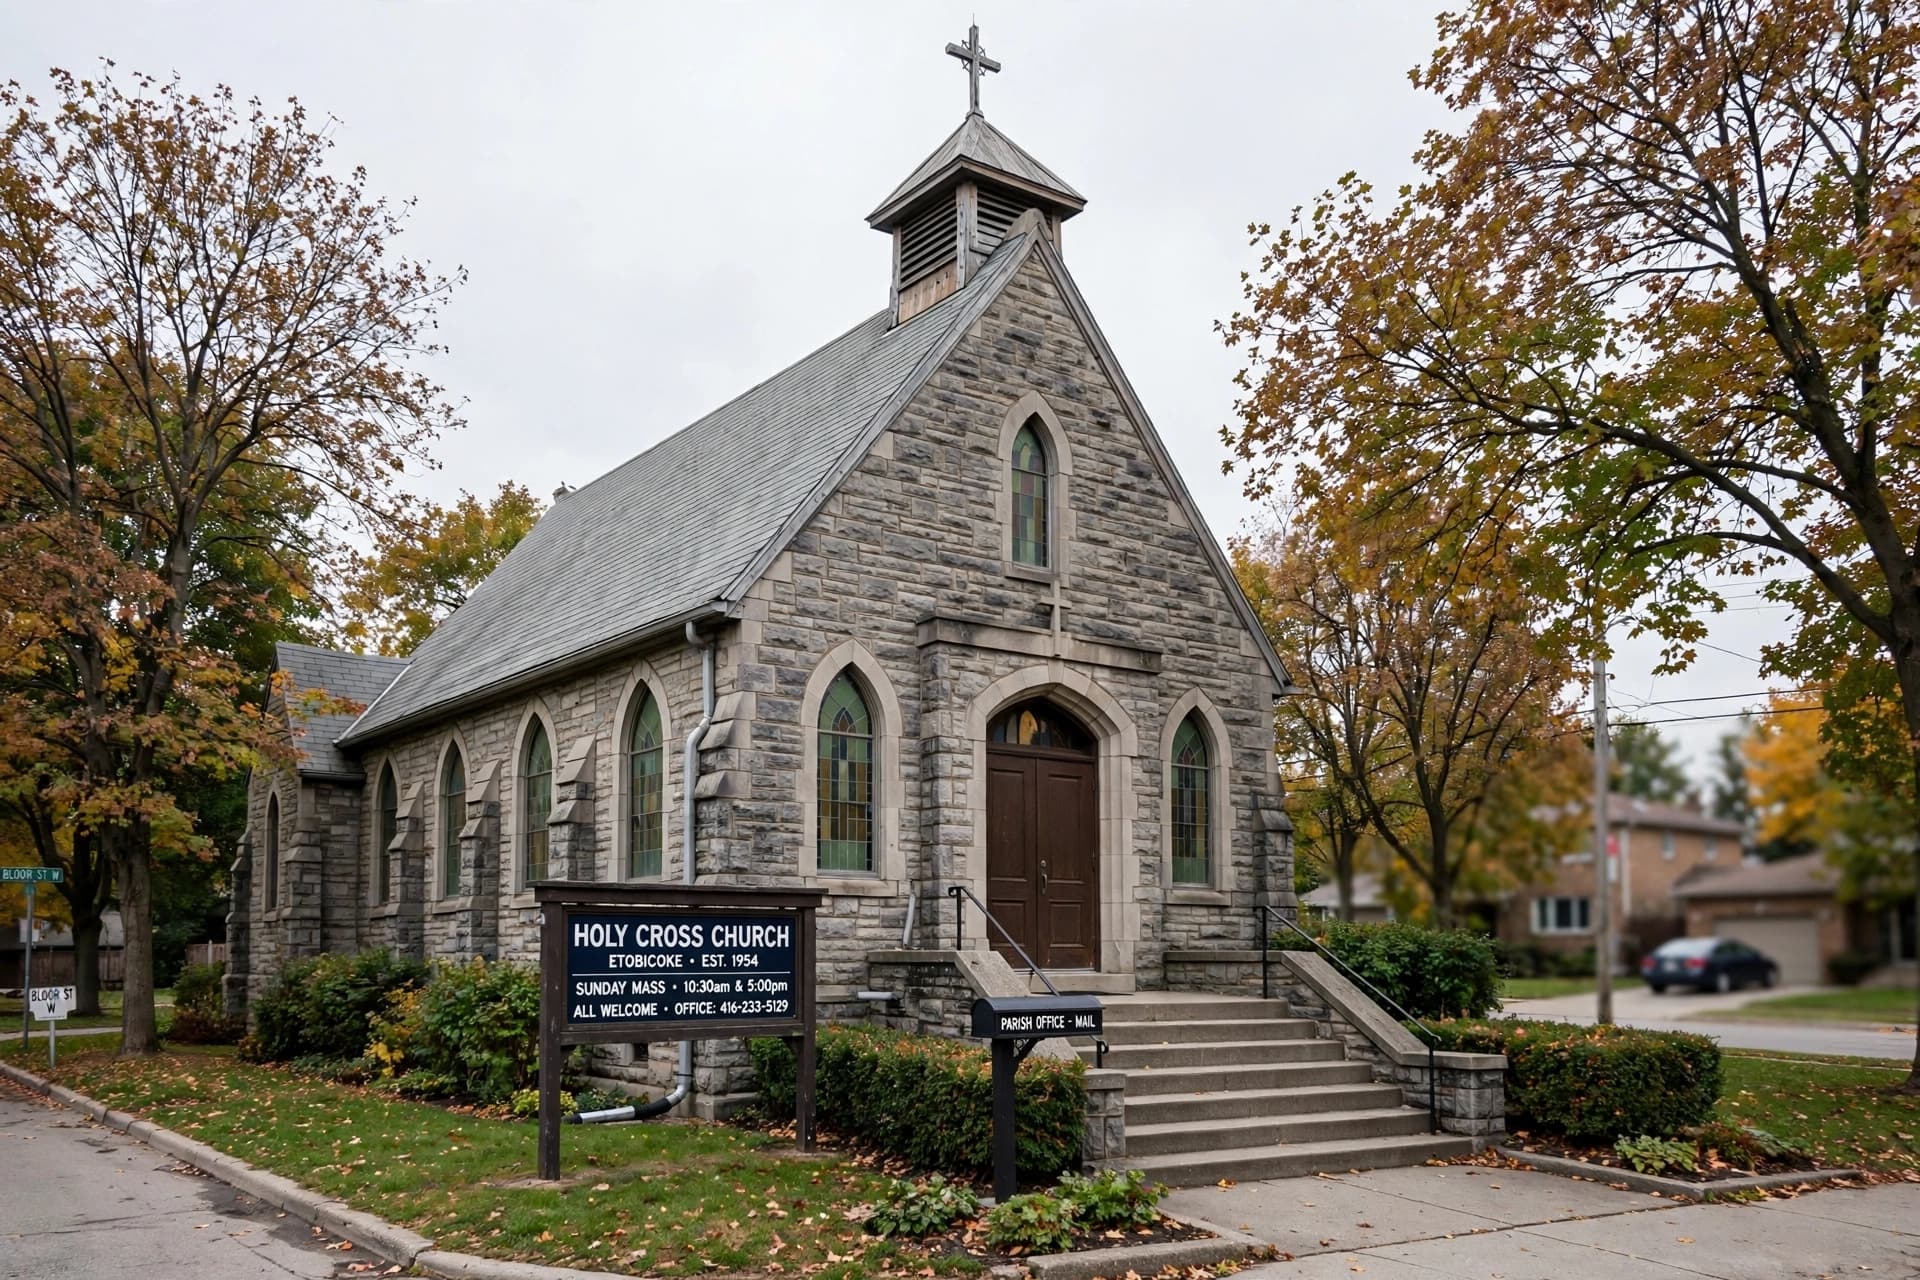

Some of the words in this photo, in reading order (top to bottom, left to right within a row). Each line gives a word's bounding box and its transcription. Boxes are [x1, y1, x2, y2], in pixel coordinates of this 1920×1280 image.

[2, 869, 33, 880] BLOOR
[37, 869, 47, 880] ST
[52, 870, 60, 880] W
[574, 923, 628, 948] HOLY
[635, 924, 704, 948] CROSS
[711, 924, 790, 948] CHURCH
[608, 954, 683, 969] ETOBICOKE
[701, 954, 727, 968] EST.
[732, 954, 759, 968] 1954
[63, 988, 73, 1000] ST
[575, 981, 627, 996] SUNDAY
[631, 980, 666, 995] MASS
[683, 979, 730, 993] 10:30am
[735, 979, 743, 992] &
[747, 979, 788, 995] 5:00pm
[47, 1002, 56, 1014] W
[573, 1005, 596, 1018] ALL
[601, 1003, 658, 1017] WELCOME
[674, 1001, 717, 1016] OFFICE:
[719, 1000, 789, 1015] 416-233-5129
[1001, 1016, 1033, 1030] PARISH
[1036, 1015, 1065, 1029] OFFICE
[1075, 1014, 1096, 1028] MAIL
